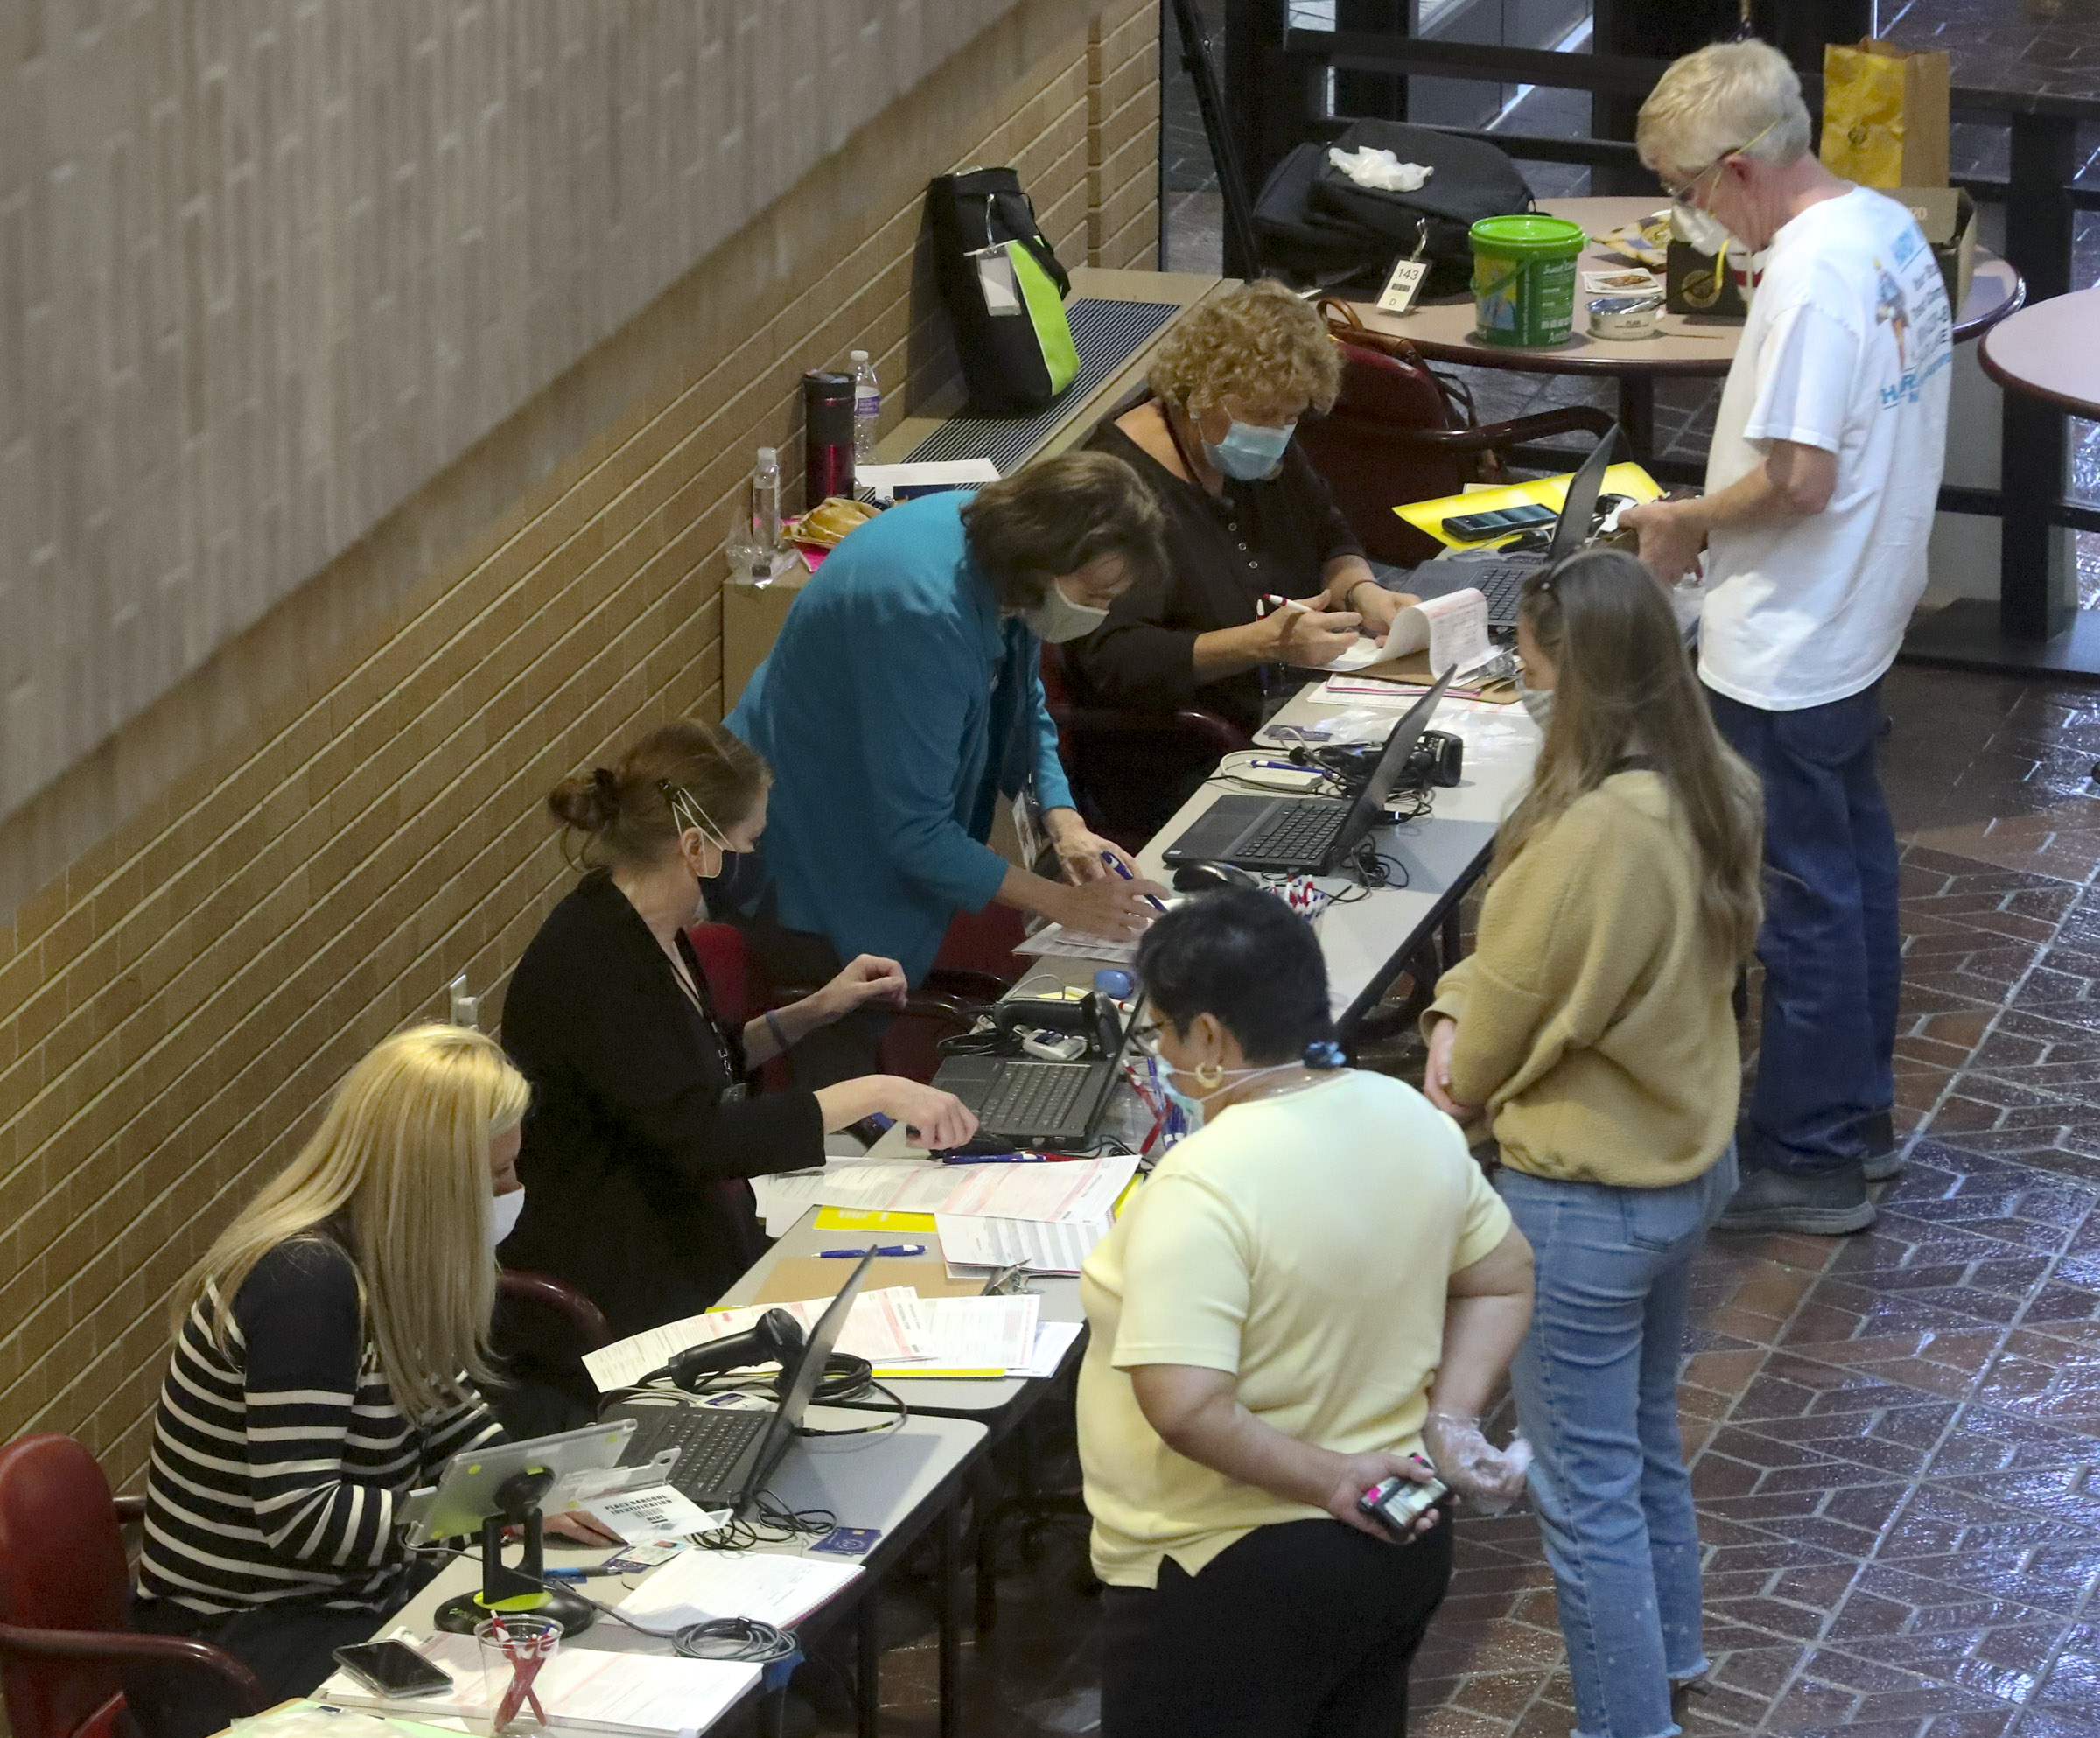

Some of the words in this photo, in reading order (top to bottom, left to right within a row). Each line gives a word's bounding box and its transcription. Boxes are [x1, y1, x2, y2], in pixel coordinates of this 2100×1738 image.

[1398, 268, 1419, 281] 143
[630, 1495, 668, 1505] BARCODE
[611, 1499, 673, 1515] IDENTIFICATION
